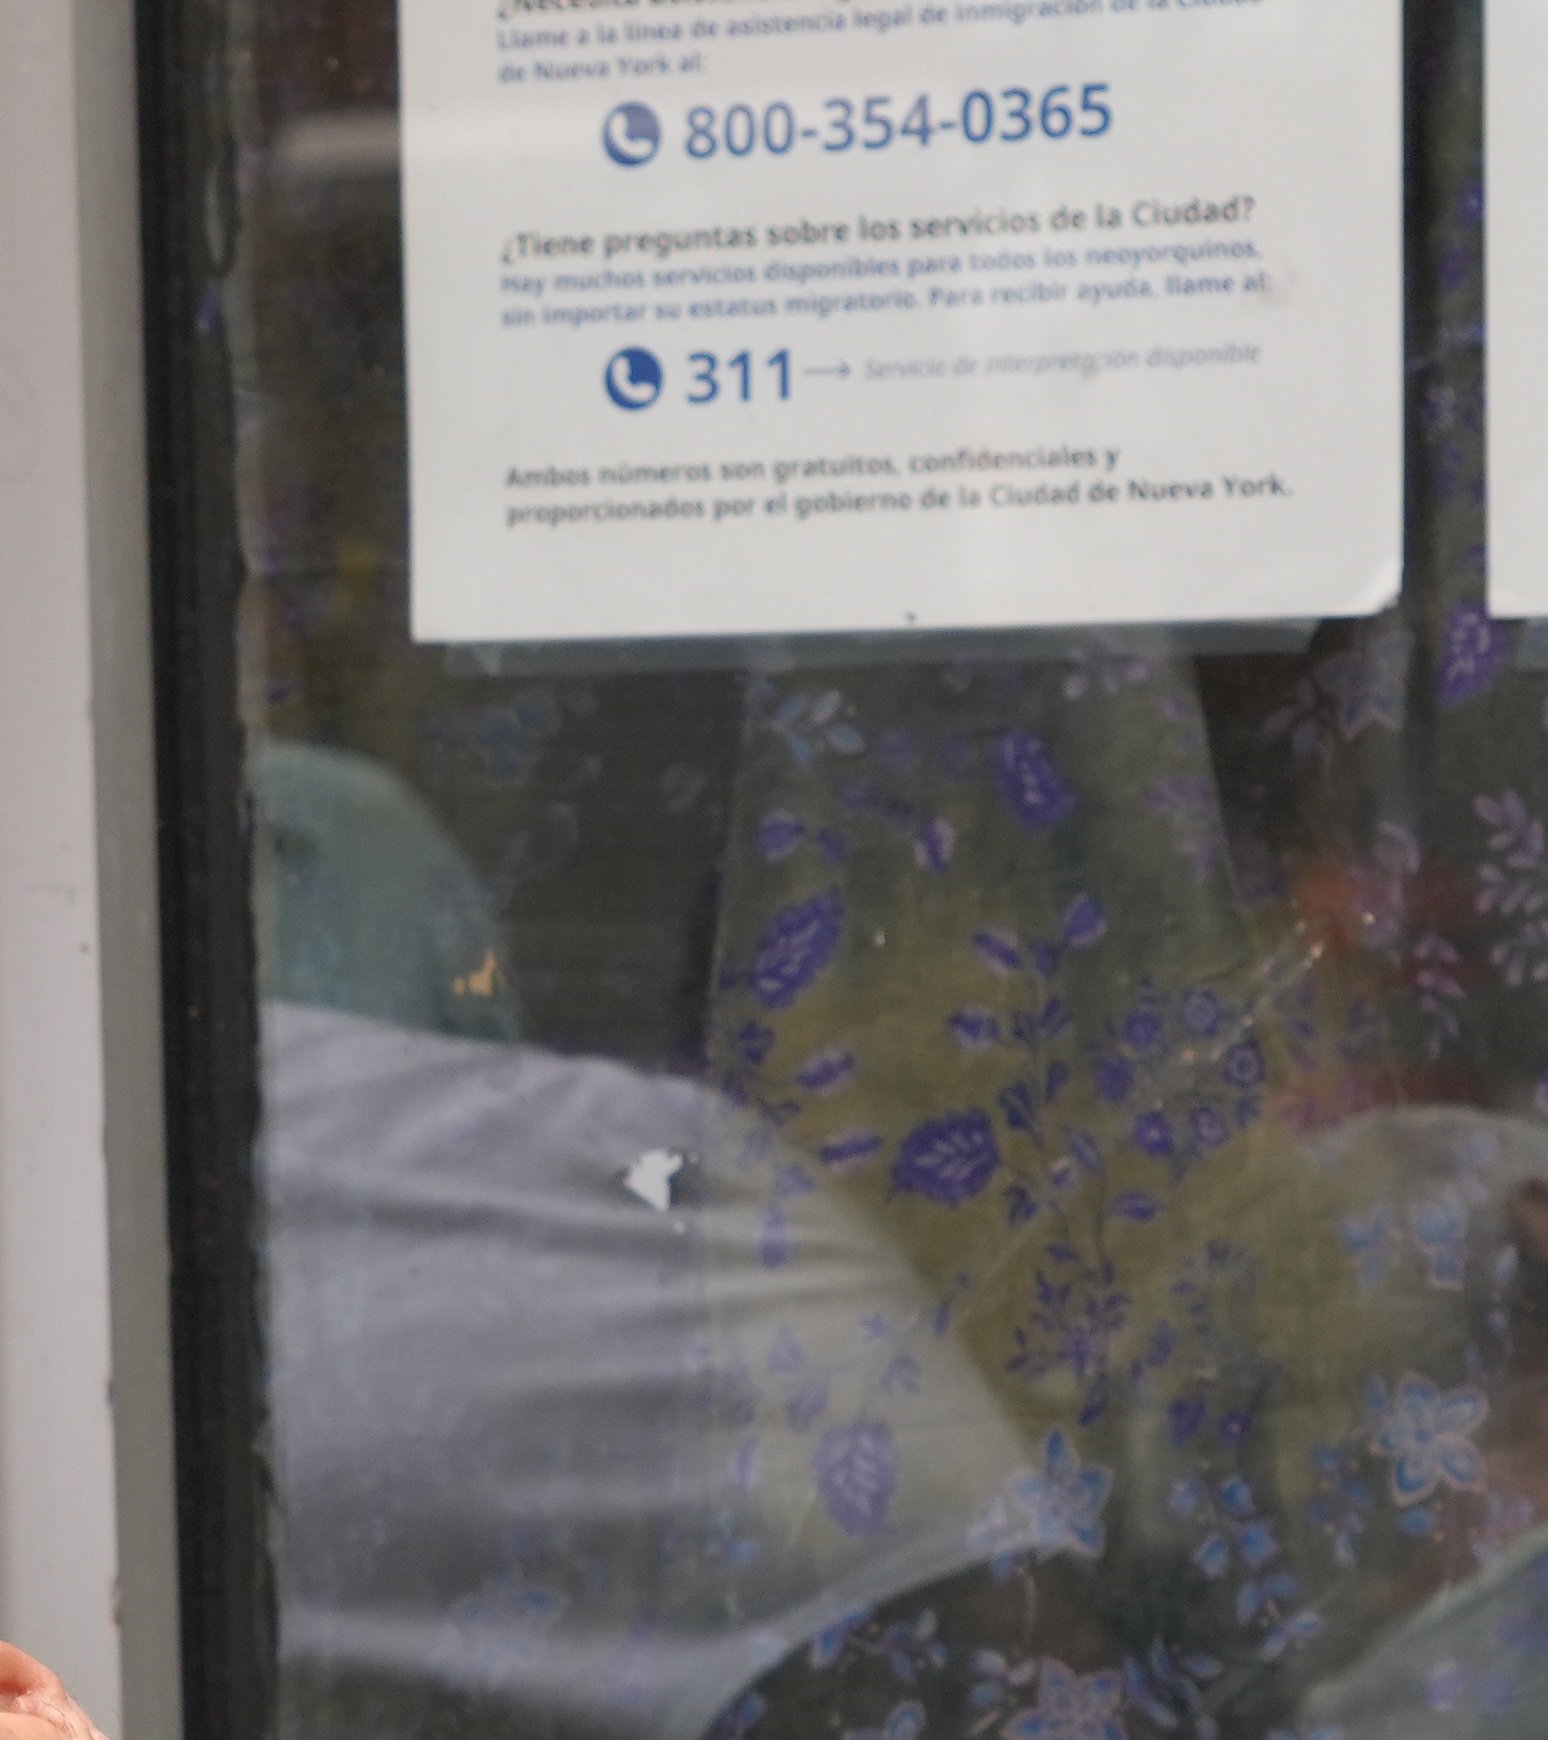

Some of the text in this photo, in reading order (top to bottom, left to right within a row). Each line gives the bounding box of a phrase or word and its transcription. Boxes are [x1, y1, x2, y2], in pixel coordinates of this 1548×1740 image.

[685, 82, 1113, 160] 800-354-0365
[500, 195, 1254, 266] ¿Tiene preguntas sobre los servicios de la Ciudad?
[687, 348, 791, 405] 311
[504, 465, 592, 489] Ambos
[718, 460, 766, 482] son
[907, 445, 1098, 475] confidenciales
[1104, 449, 1120, 473] y
[505, 472, 1292, 529] proporcionados por el gobierno de la Ciudad de Nueva York.
